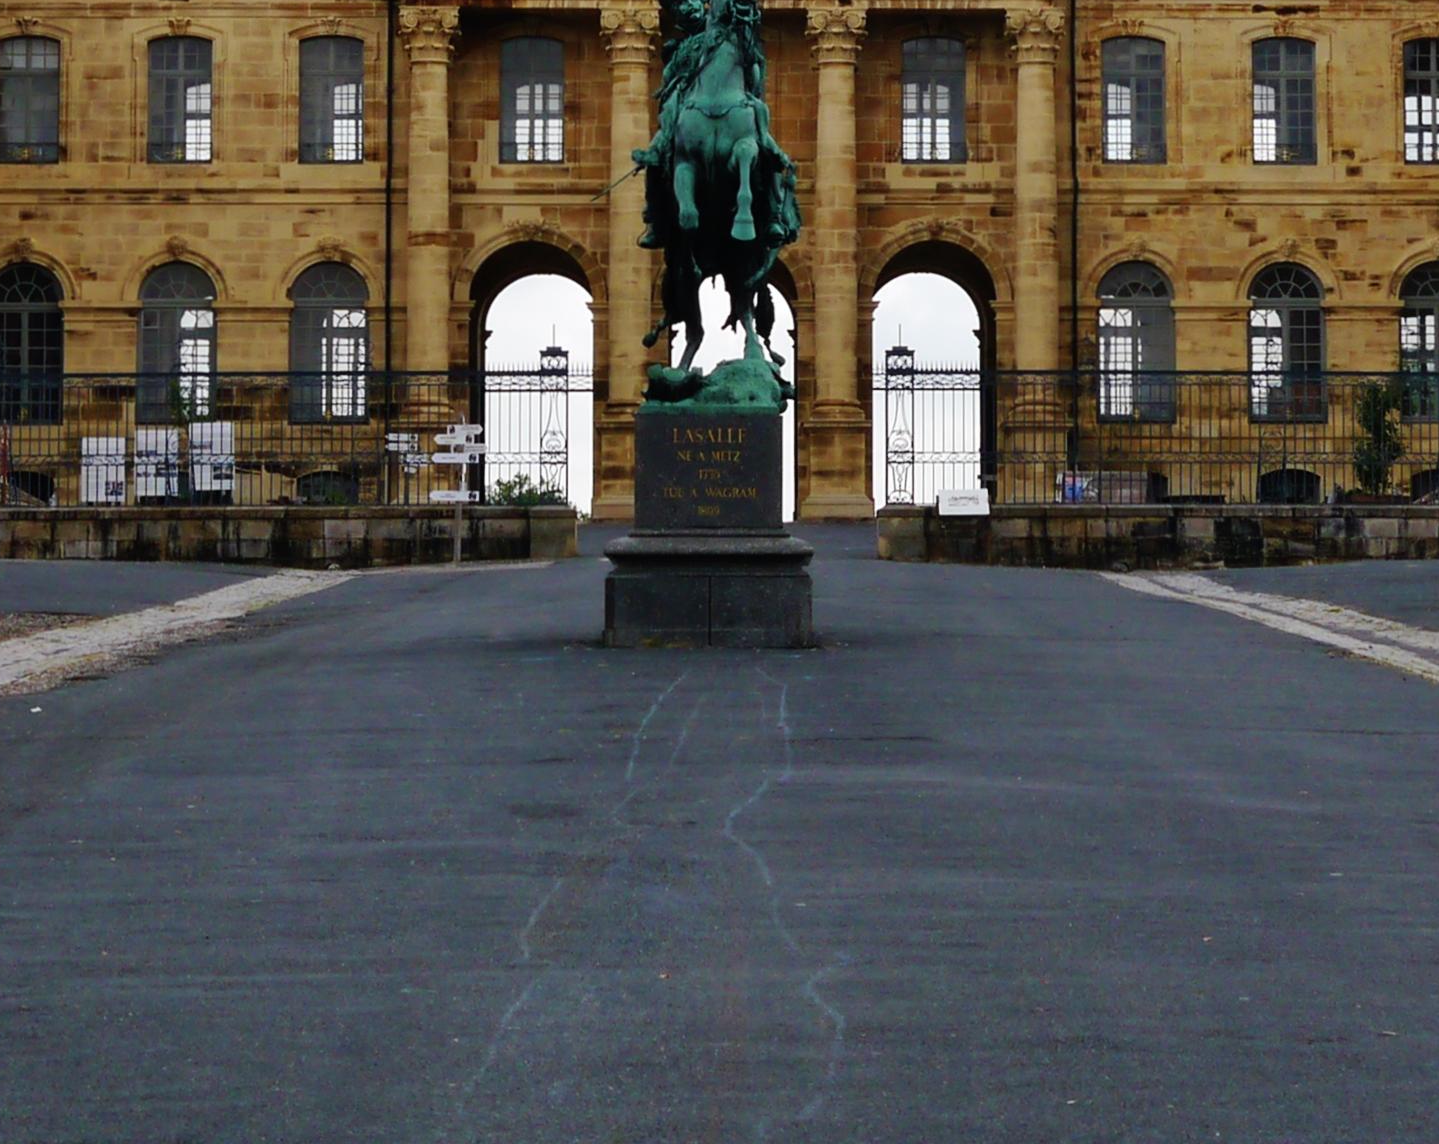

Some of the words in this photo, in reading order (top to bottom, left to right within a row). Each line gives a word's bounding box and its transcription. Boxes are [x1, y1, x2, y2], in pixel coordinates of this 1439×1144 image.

[672, 428, 746, 444] LASALLE
[712, 450, 742, 463] METZ
[704, 487, 757, 498] WAGRAM
